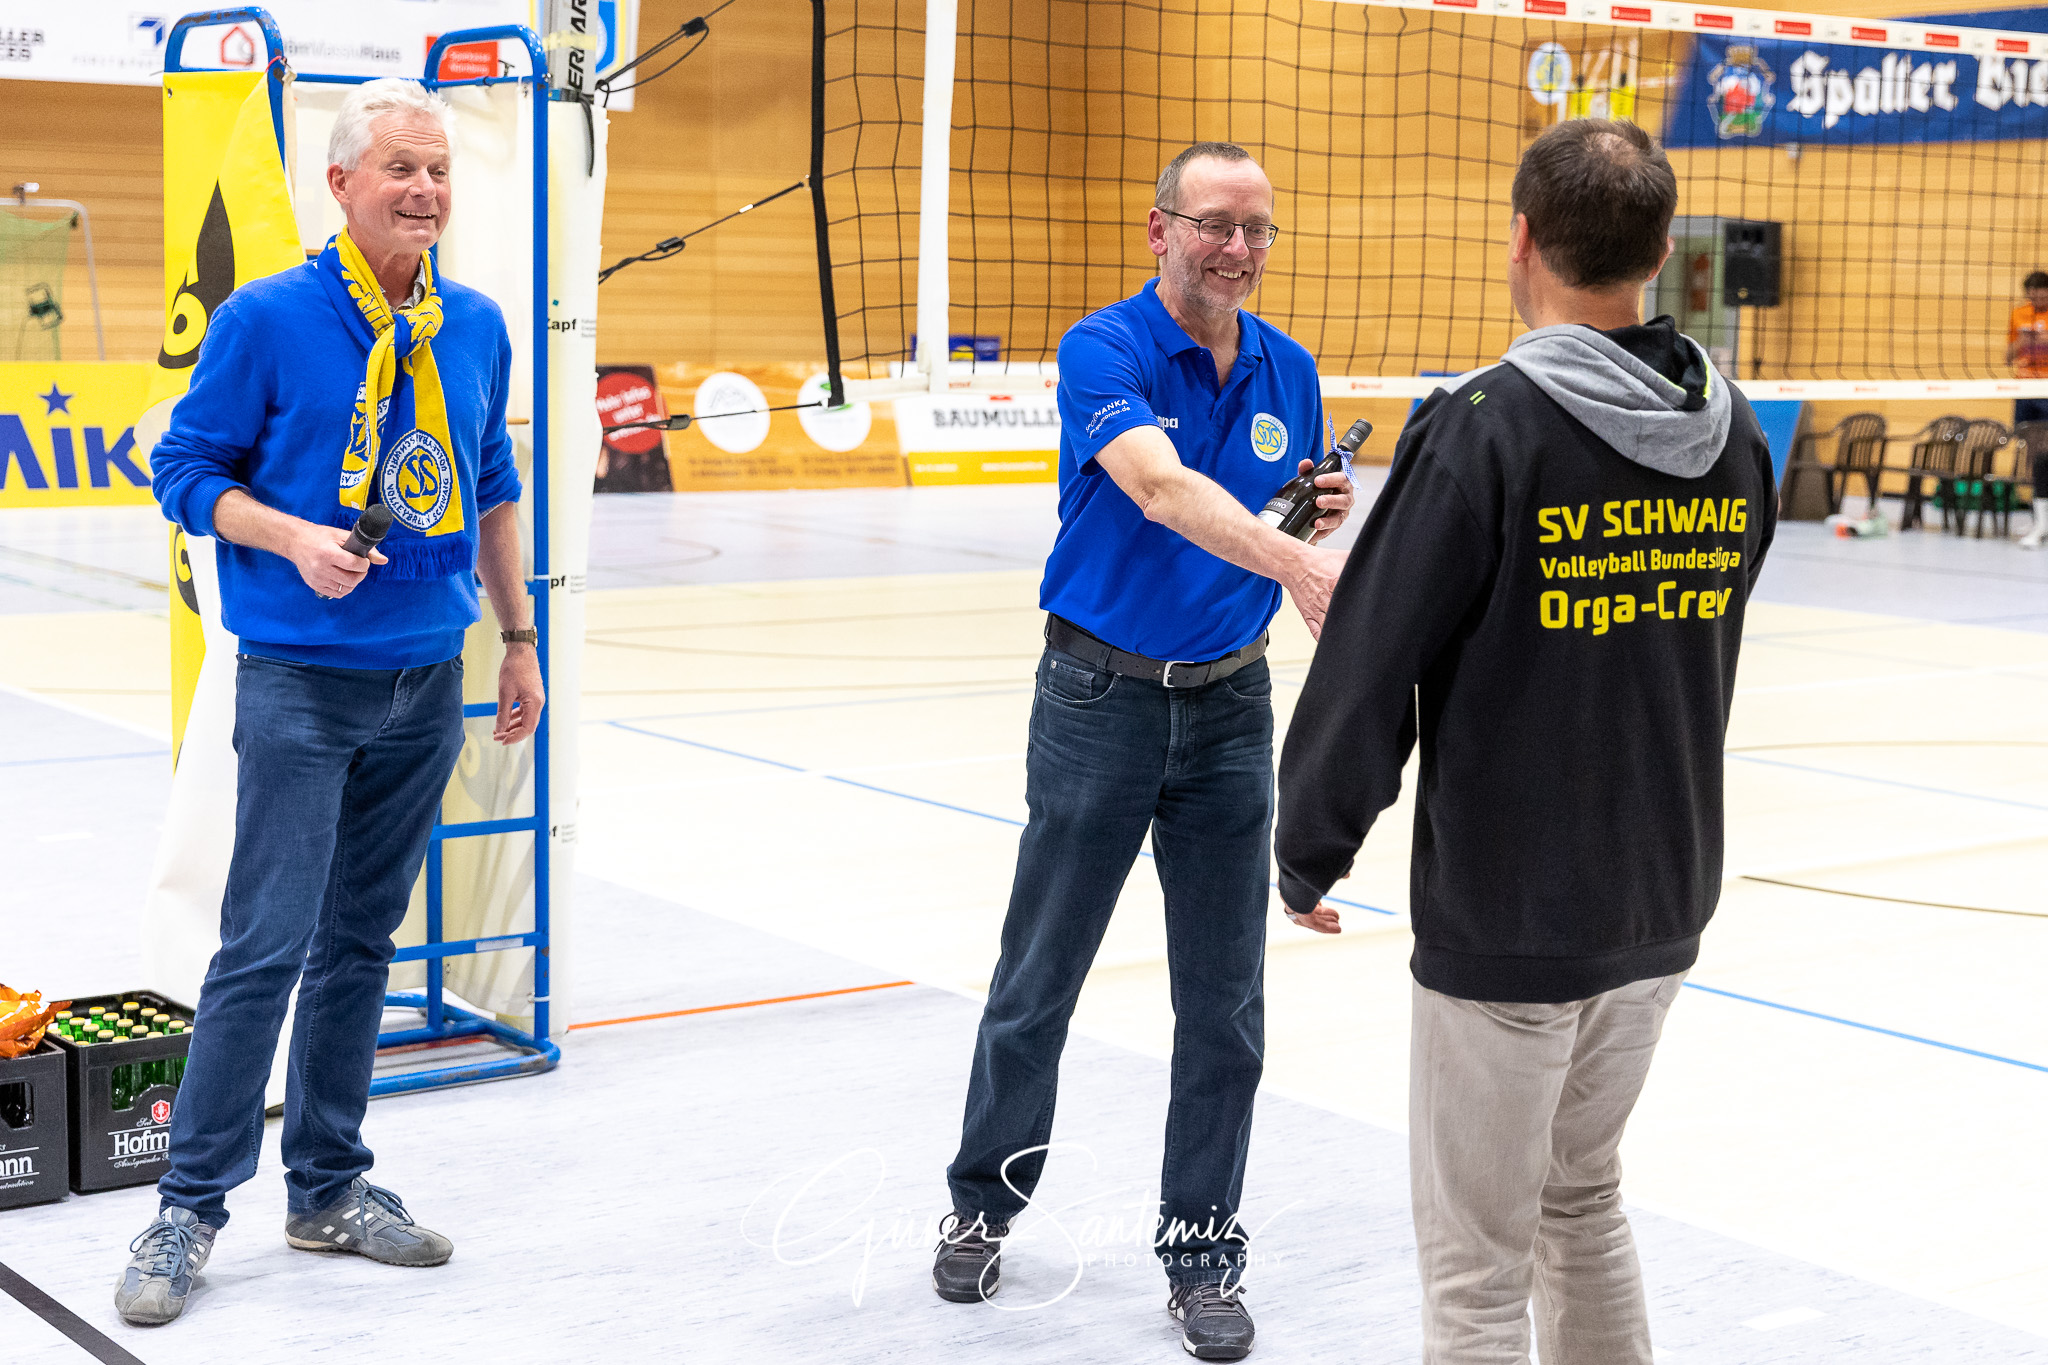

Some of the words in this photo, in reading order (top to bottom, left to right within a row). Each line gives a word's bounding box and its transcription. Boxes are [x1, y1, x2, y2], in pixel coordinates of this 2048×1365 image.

[1786, 50, 1957, 129] Spalter
[1538, 504, 1589, 543] SV
[1603, 497, 1747, 538] SCHWAIG
[1539, 550, 1647, 580] Volleyball
[1650, 547, 1741, 572] Bundesliga
[1540, 580, 1733, 636] Orga-Crew
